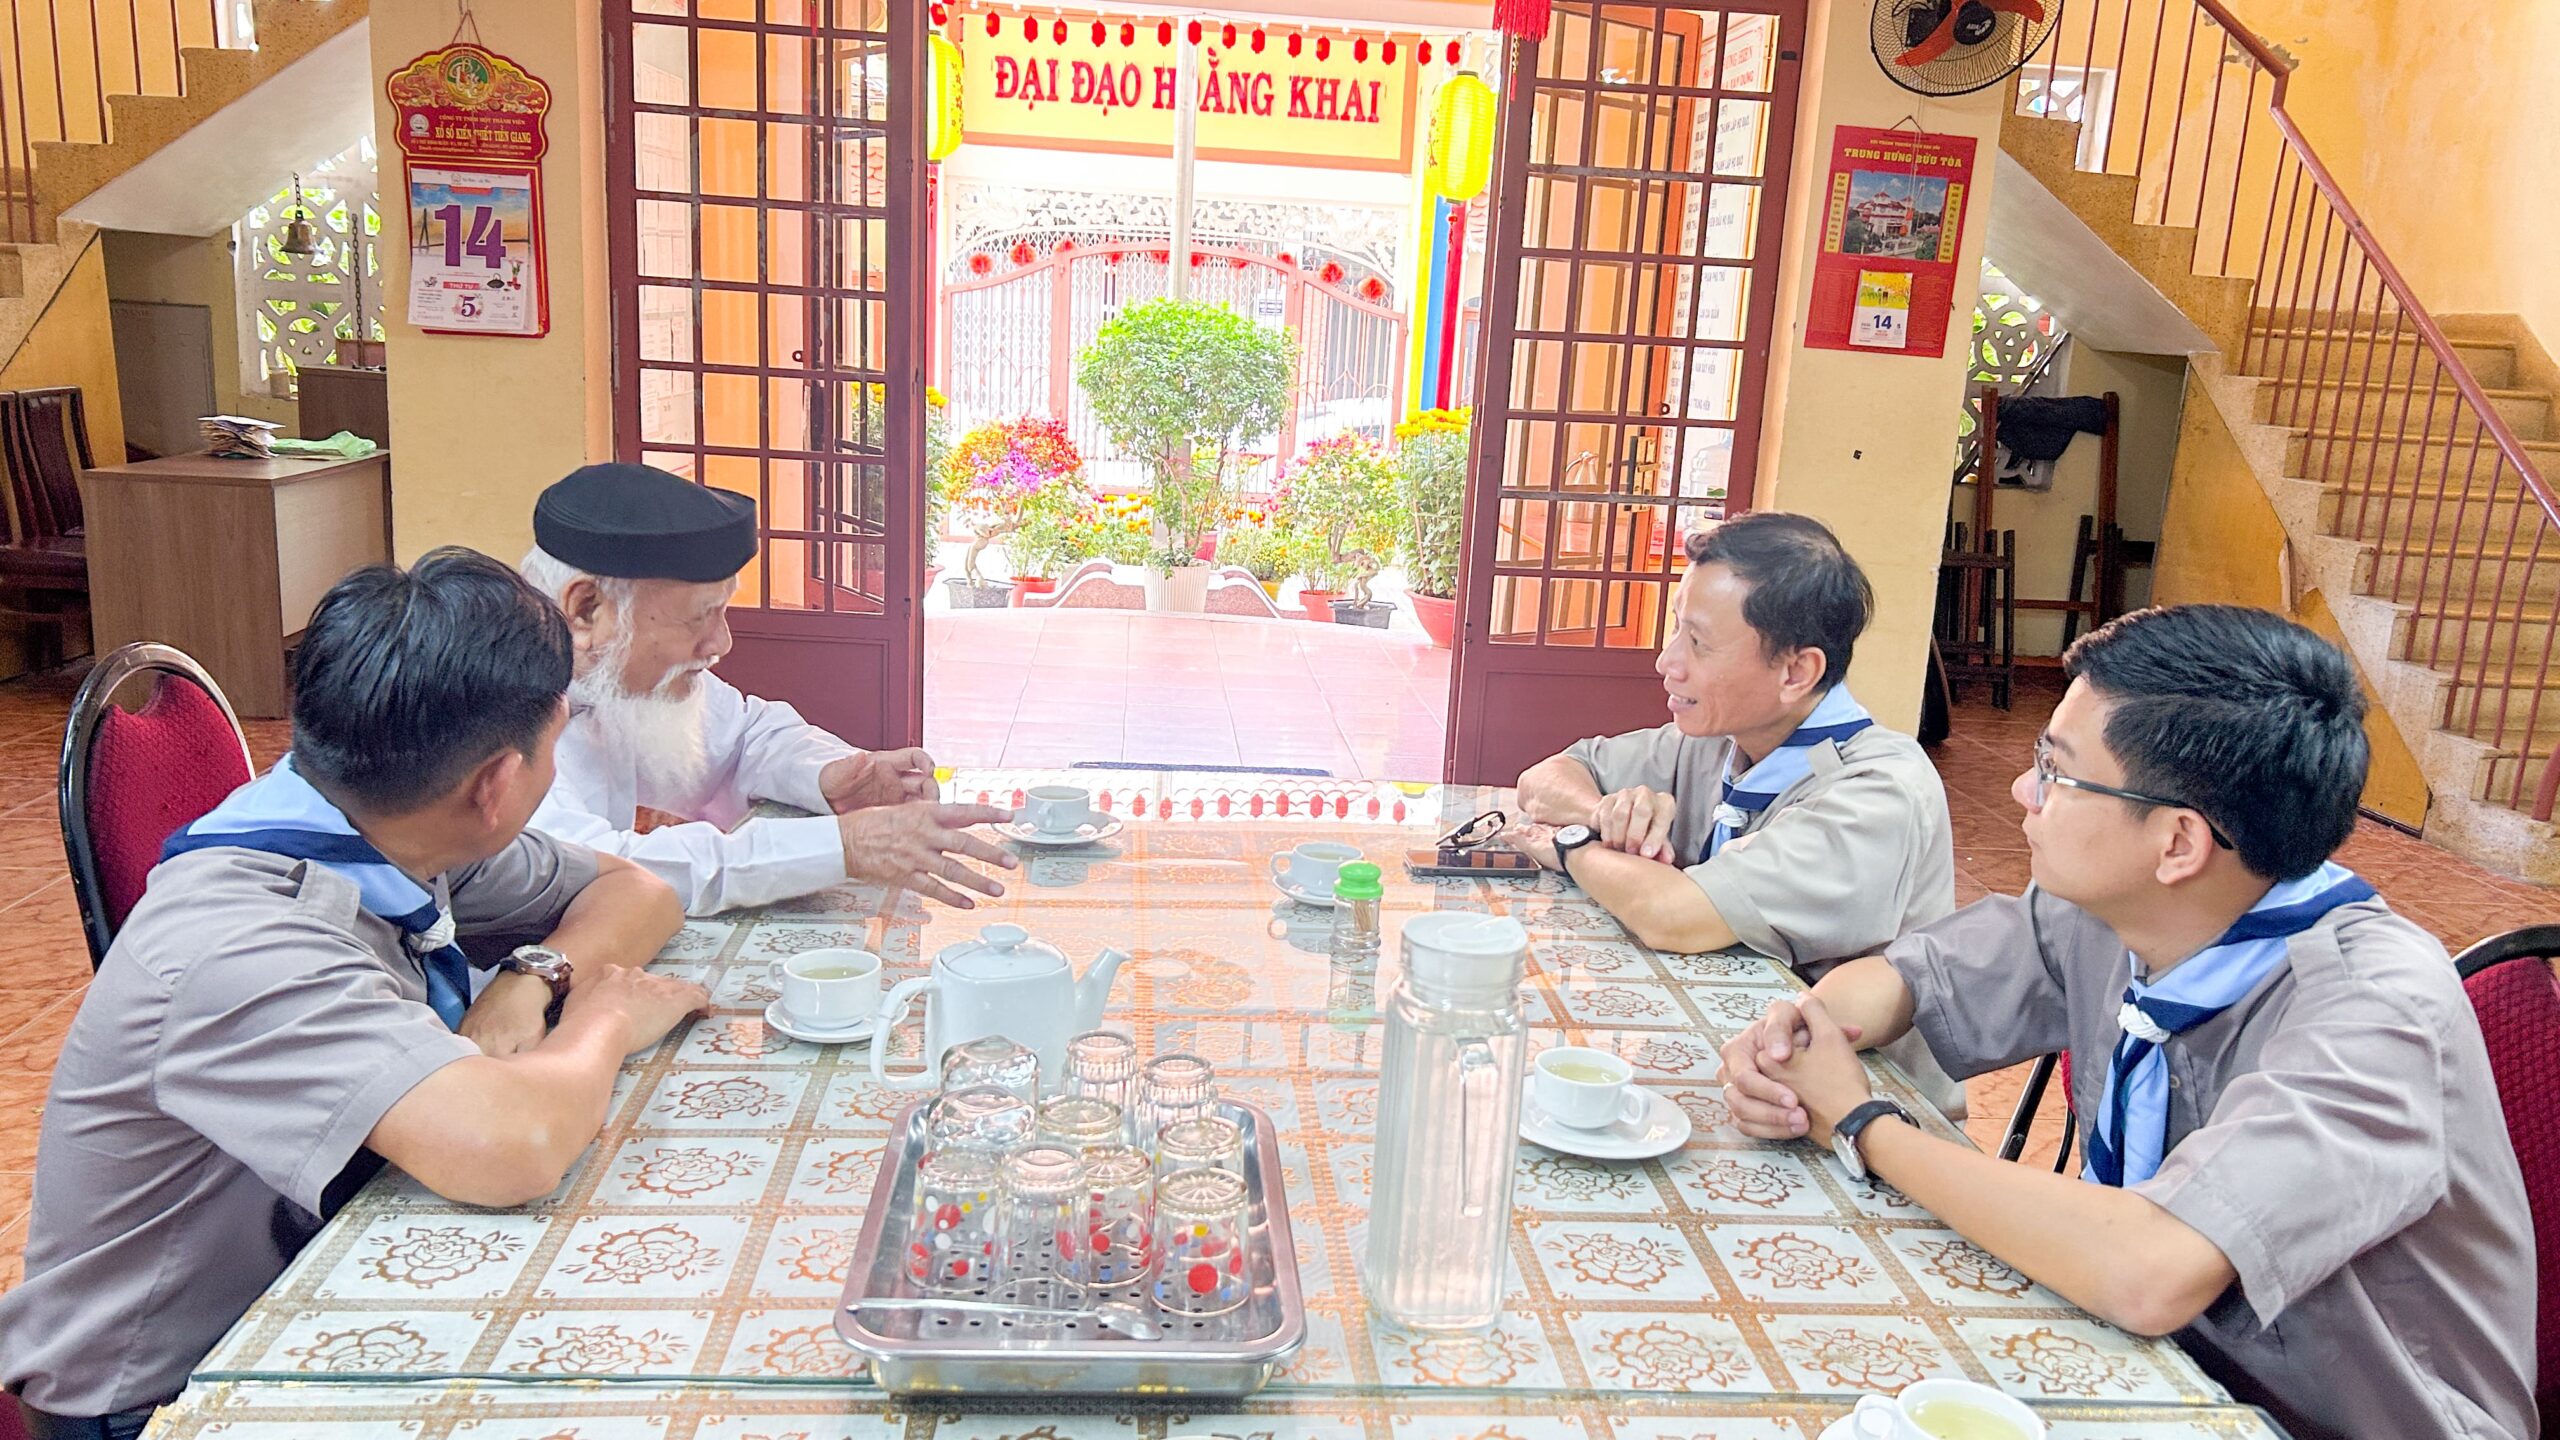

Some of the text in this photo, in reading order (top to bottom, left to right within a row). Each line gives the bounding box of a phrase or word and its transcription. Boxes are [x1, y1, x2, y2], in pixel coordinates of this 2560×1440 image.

[995, 47, 1381, 123] ĐẠI ĐẠO HẰNG KHAI
[435, 121, 445, 138] XỔ
[445, 123, 455, 138] SỐ
[455, 123, 472, 139] KIẾN
[494, 125, 509, 142] TIỀN
[510, 131, 532, 143] GIANG
[1843, 147, 1880, 160] TRUNG
[1883, 150, 1912, 163] HƯNG
[1940, 155, 1962, 168] TÒA
[434, 204, 507, 269] 14
[461, 296, 476, 317] 5
[1873, 314, 1892, 329] 14
